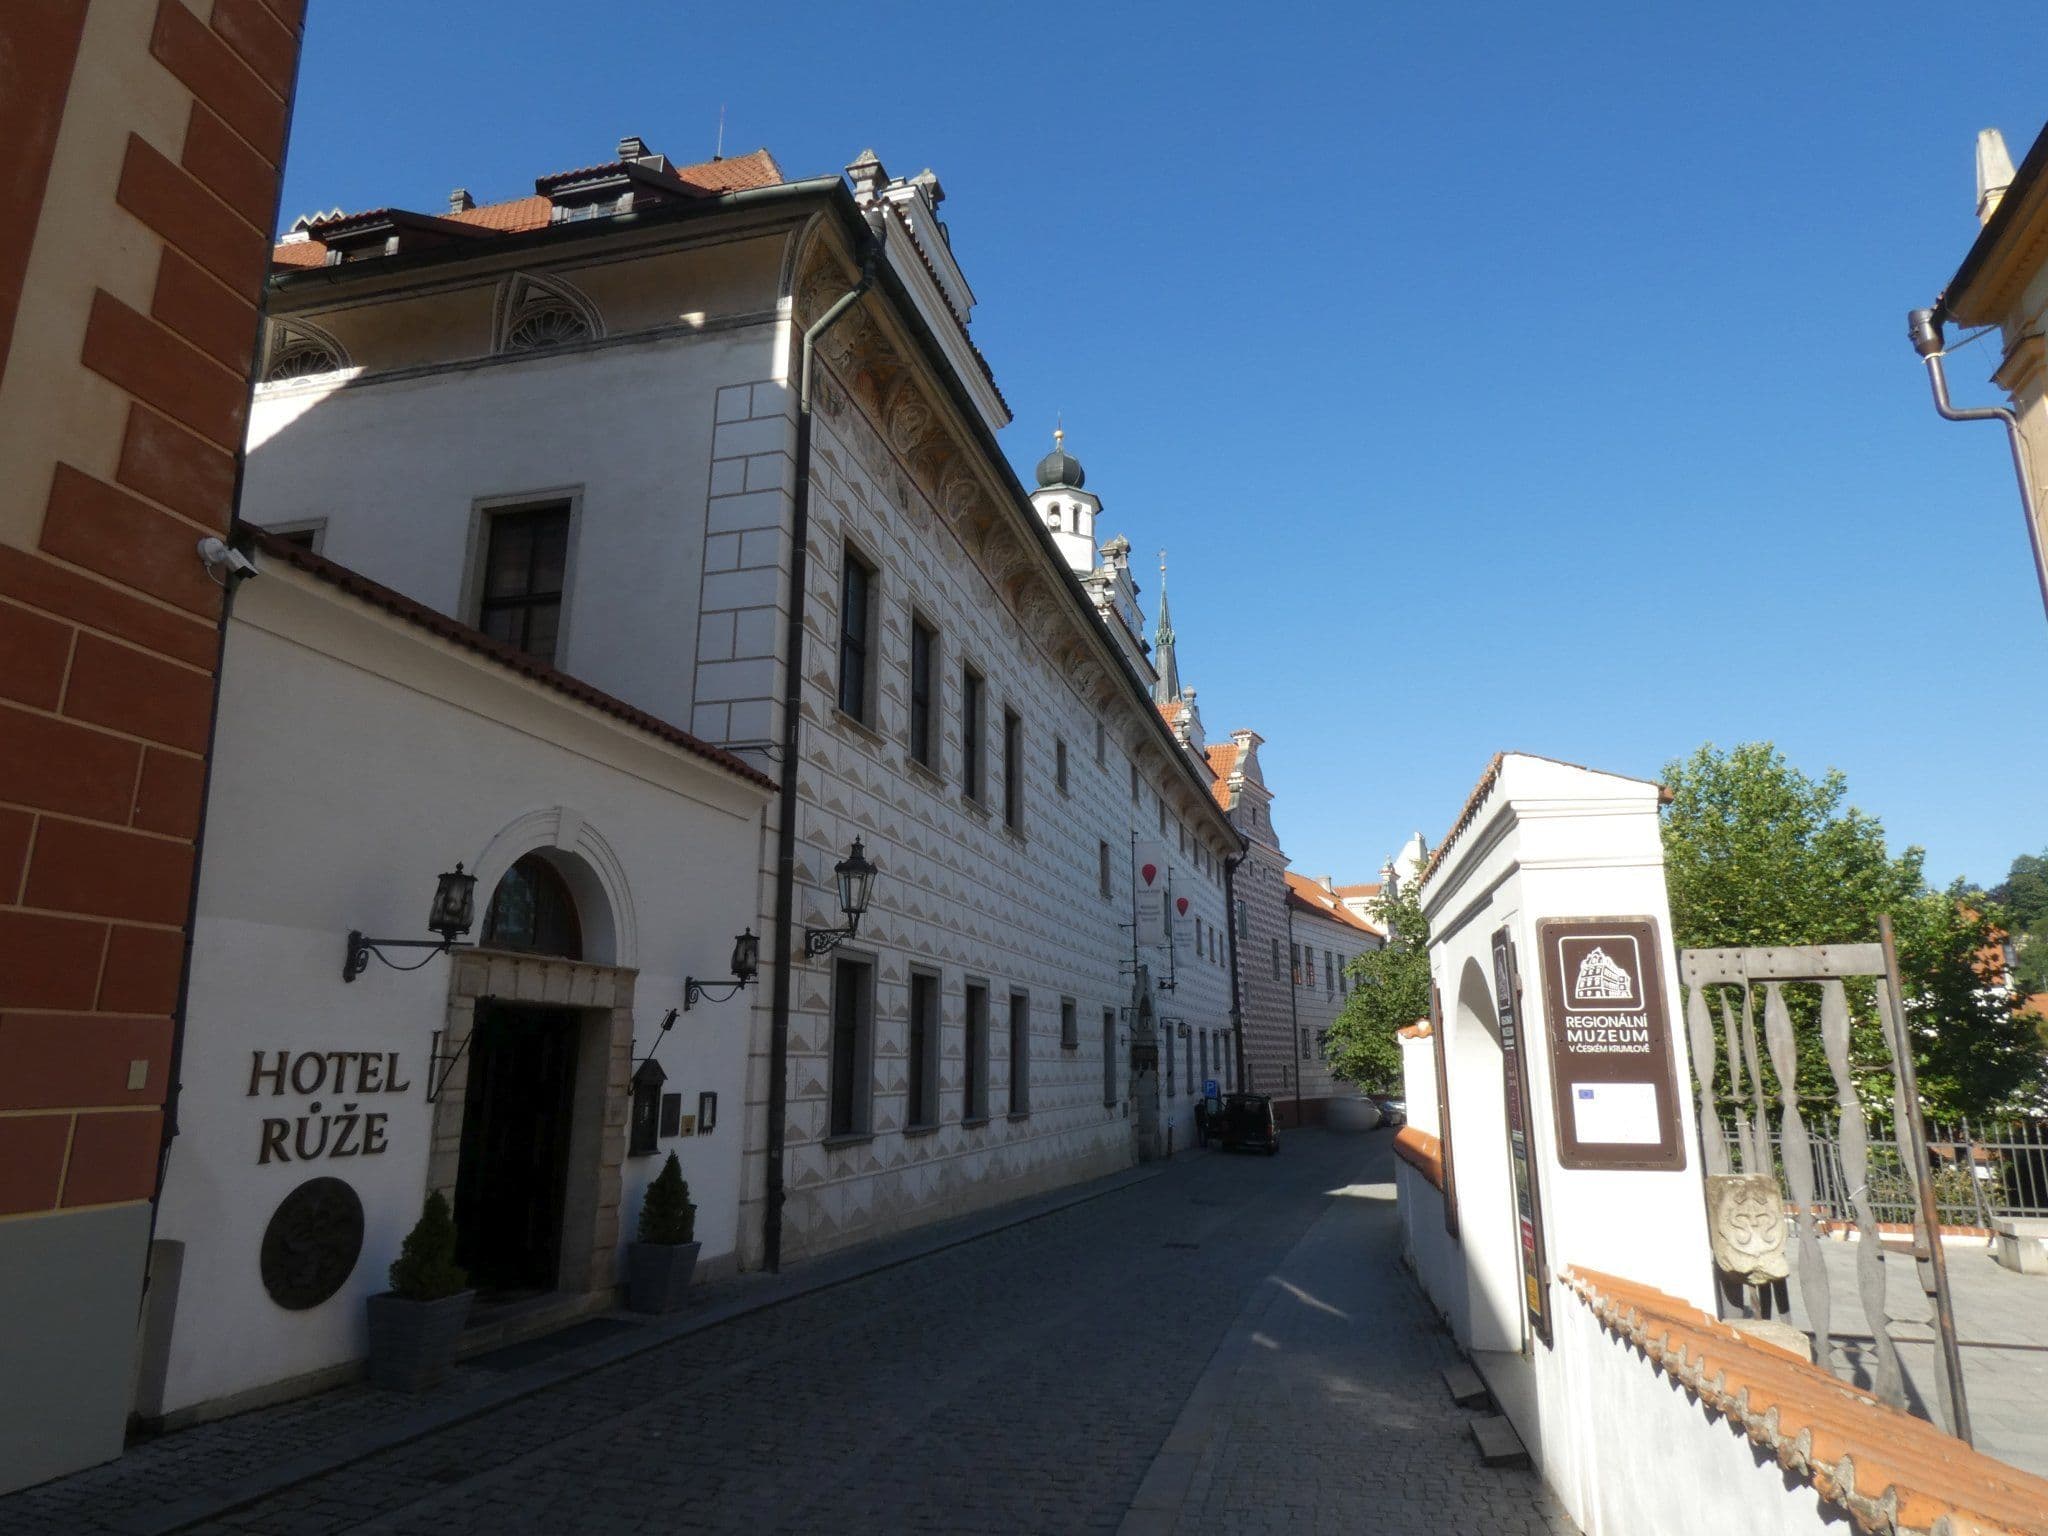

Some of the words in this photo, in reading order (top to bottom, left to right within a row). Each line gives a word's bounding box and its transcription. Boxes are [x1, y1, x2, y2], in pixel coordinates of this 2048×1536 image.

[1566, 1013, 1648, 1028] REGIONÁLNÍ
[1567, 1029, 1648, 1043] MUZEUM
[246, 1050, 411, 1096] HOTEL
[257, 1101, 389, 1165] RŮŽE
